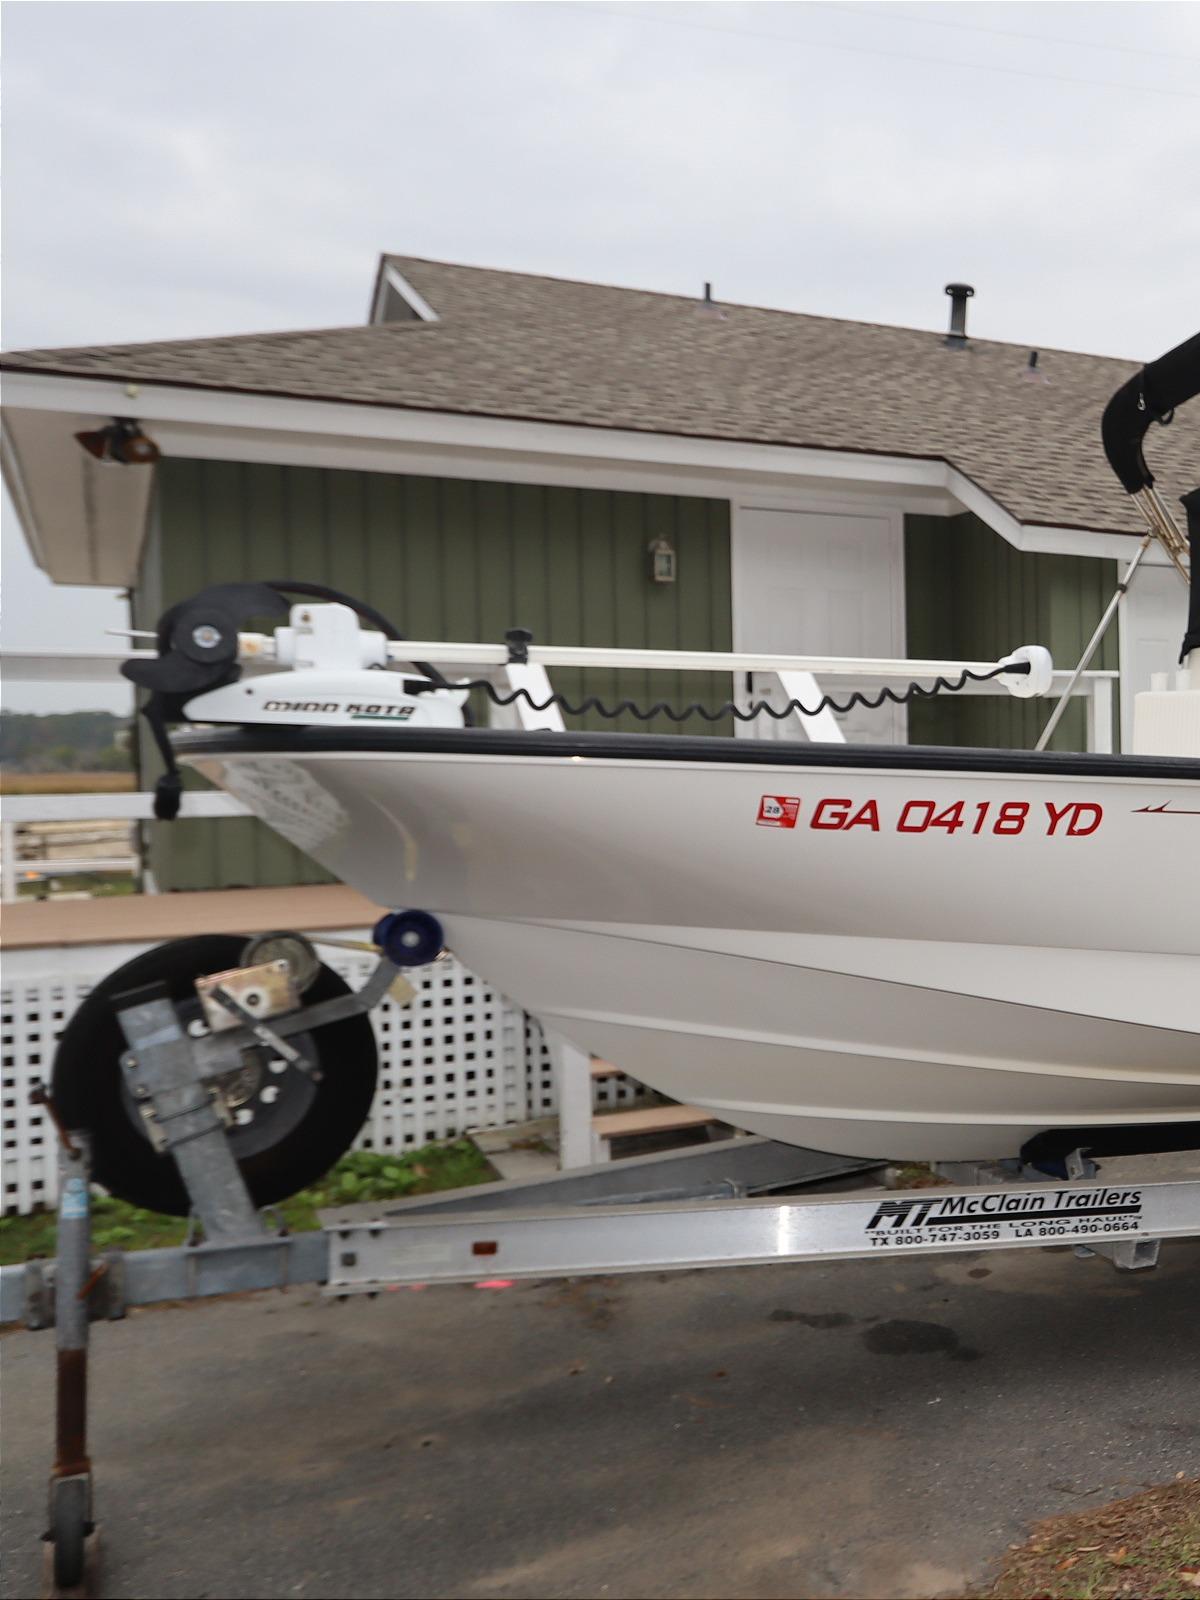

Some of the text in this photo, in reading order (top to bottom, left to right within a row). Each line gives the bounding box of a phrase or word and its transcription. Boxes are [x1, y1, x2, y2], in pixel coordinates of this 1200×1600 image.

[346, 704, 416, 715] KOTA
[810, 799, 881, 832] GA
[896, 801, 1029, 835] 0418
[1045, 802, 1103, 836] YD
[939, 1193, 1045, 1215] McClain
[1055, 1188, 1142, 1208] Trailers
[871, 1221, 1139, 1246] TX 800-747-3059 LA 800-490-0664
[928, 1225, 962, 1233] FOR
[970, 1222, 1000, 1231] THE
[1009, 1219, 1071, 1228] LONG
